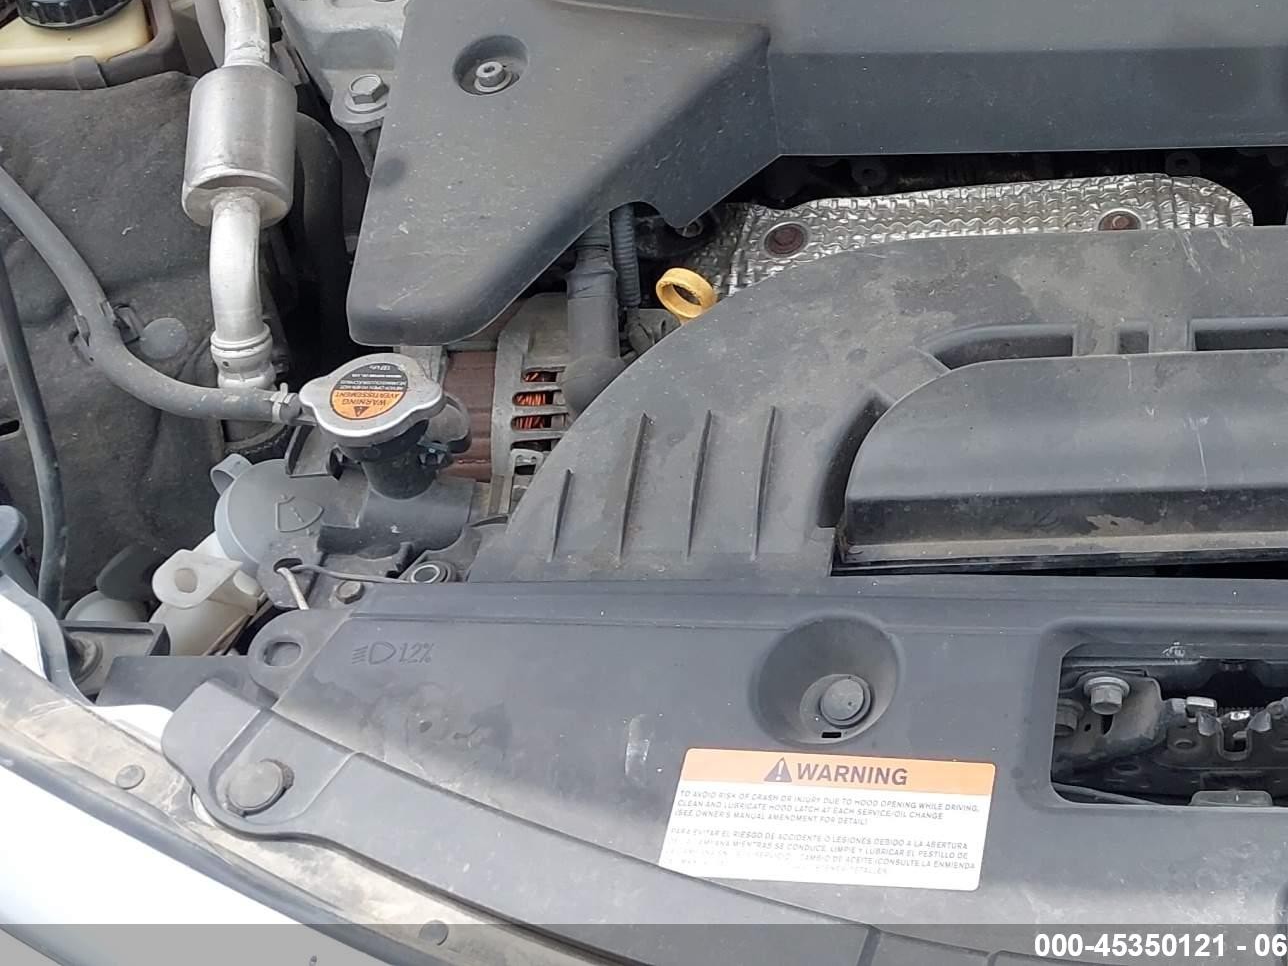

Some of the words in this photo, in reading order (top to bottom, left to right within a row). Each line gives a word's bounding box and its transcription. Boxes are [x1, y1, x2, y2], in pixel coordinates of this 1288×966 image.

[342, 398, 387, 406] WARNING
[797, 762, 909, 785] WARNING
[677, 799, 704, 808] CLEAN
[833, 807, 855, 815] EACH
[909, 811, 944, 820] CHANGE
[842, 798, 852, 806] TO
[854, 799, 878, 807] HOOD
[880, 800, 917, 809] OPENING
[918, 802, 943, 810] WHILE
[732, 831, 762, 839] RIESGO
[926, 841, 969, 850] ABERTURA
[918, 850, 955, 859] PESTILLO
[933, 860, 976, 870] ENMIENDA
